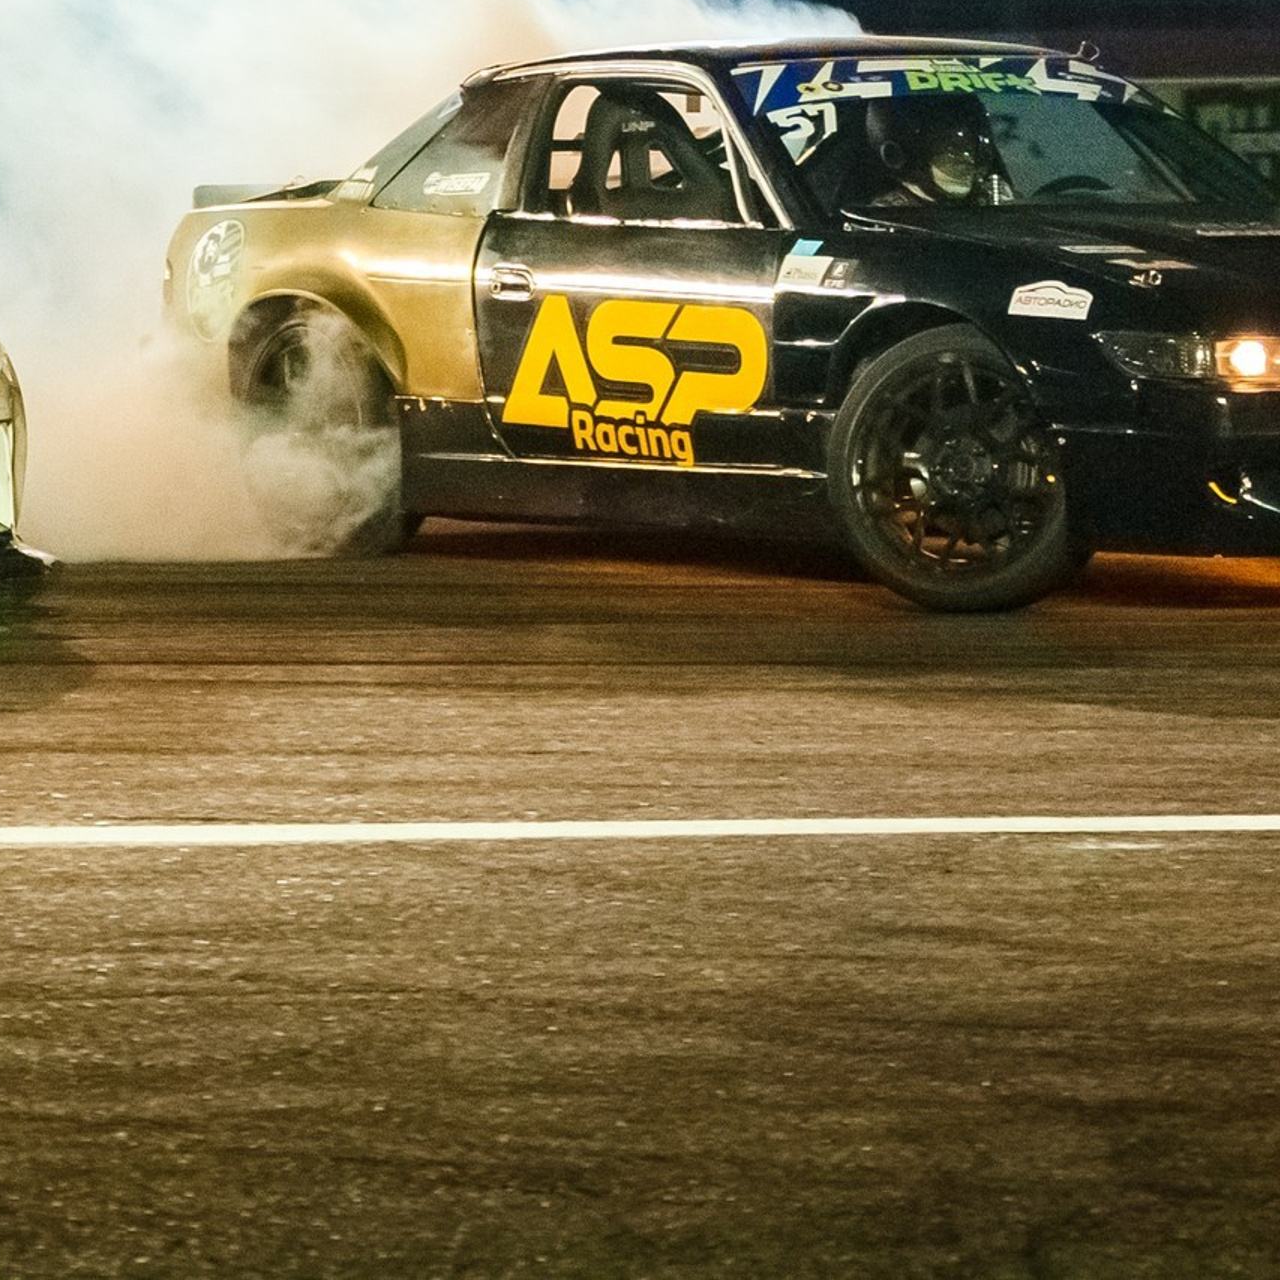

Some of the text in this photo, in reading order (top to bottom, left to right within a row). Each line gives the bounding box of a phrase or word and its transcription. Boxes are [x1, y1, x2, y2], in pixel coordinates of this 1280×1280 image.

[1014, 296, 1088, 310] АВТОРАДИО
[501, 294, 768, 429] ASP
[570, 409, 695, 468] Racing
